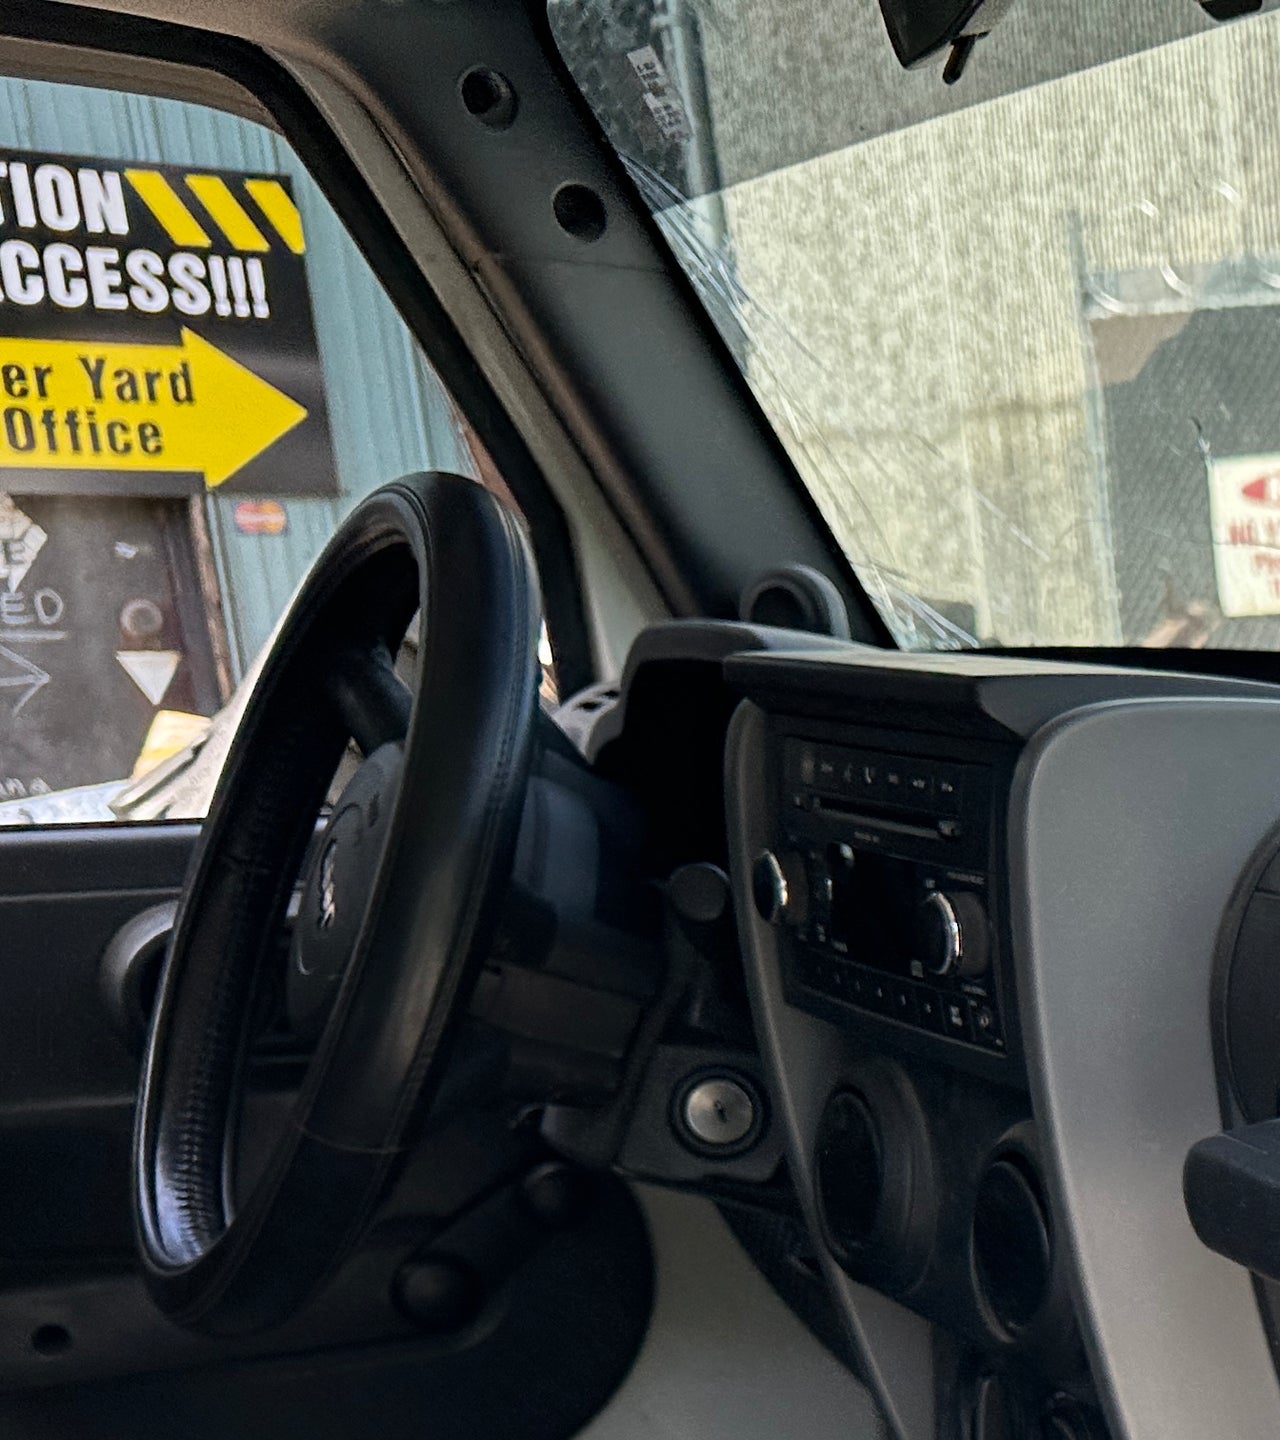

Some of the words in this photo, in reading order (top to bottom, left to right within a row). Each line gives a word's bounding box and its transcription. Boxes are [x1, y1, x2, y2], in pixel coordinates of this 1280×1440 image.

[0, 161, 129, 235] ION
[0, 239, 270, 318] CCESS!!!
[78, 356, 197, 405] Yard
[3, 406, 164, 456] Office
